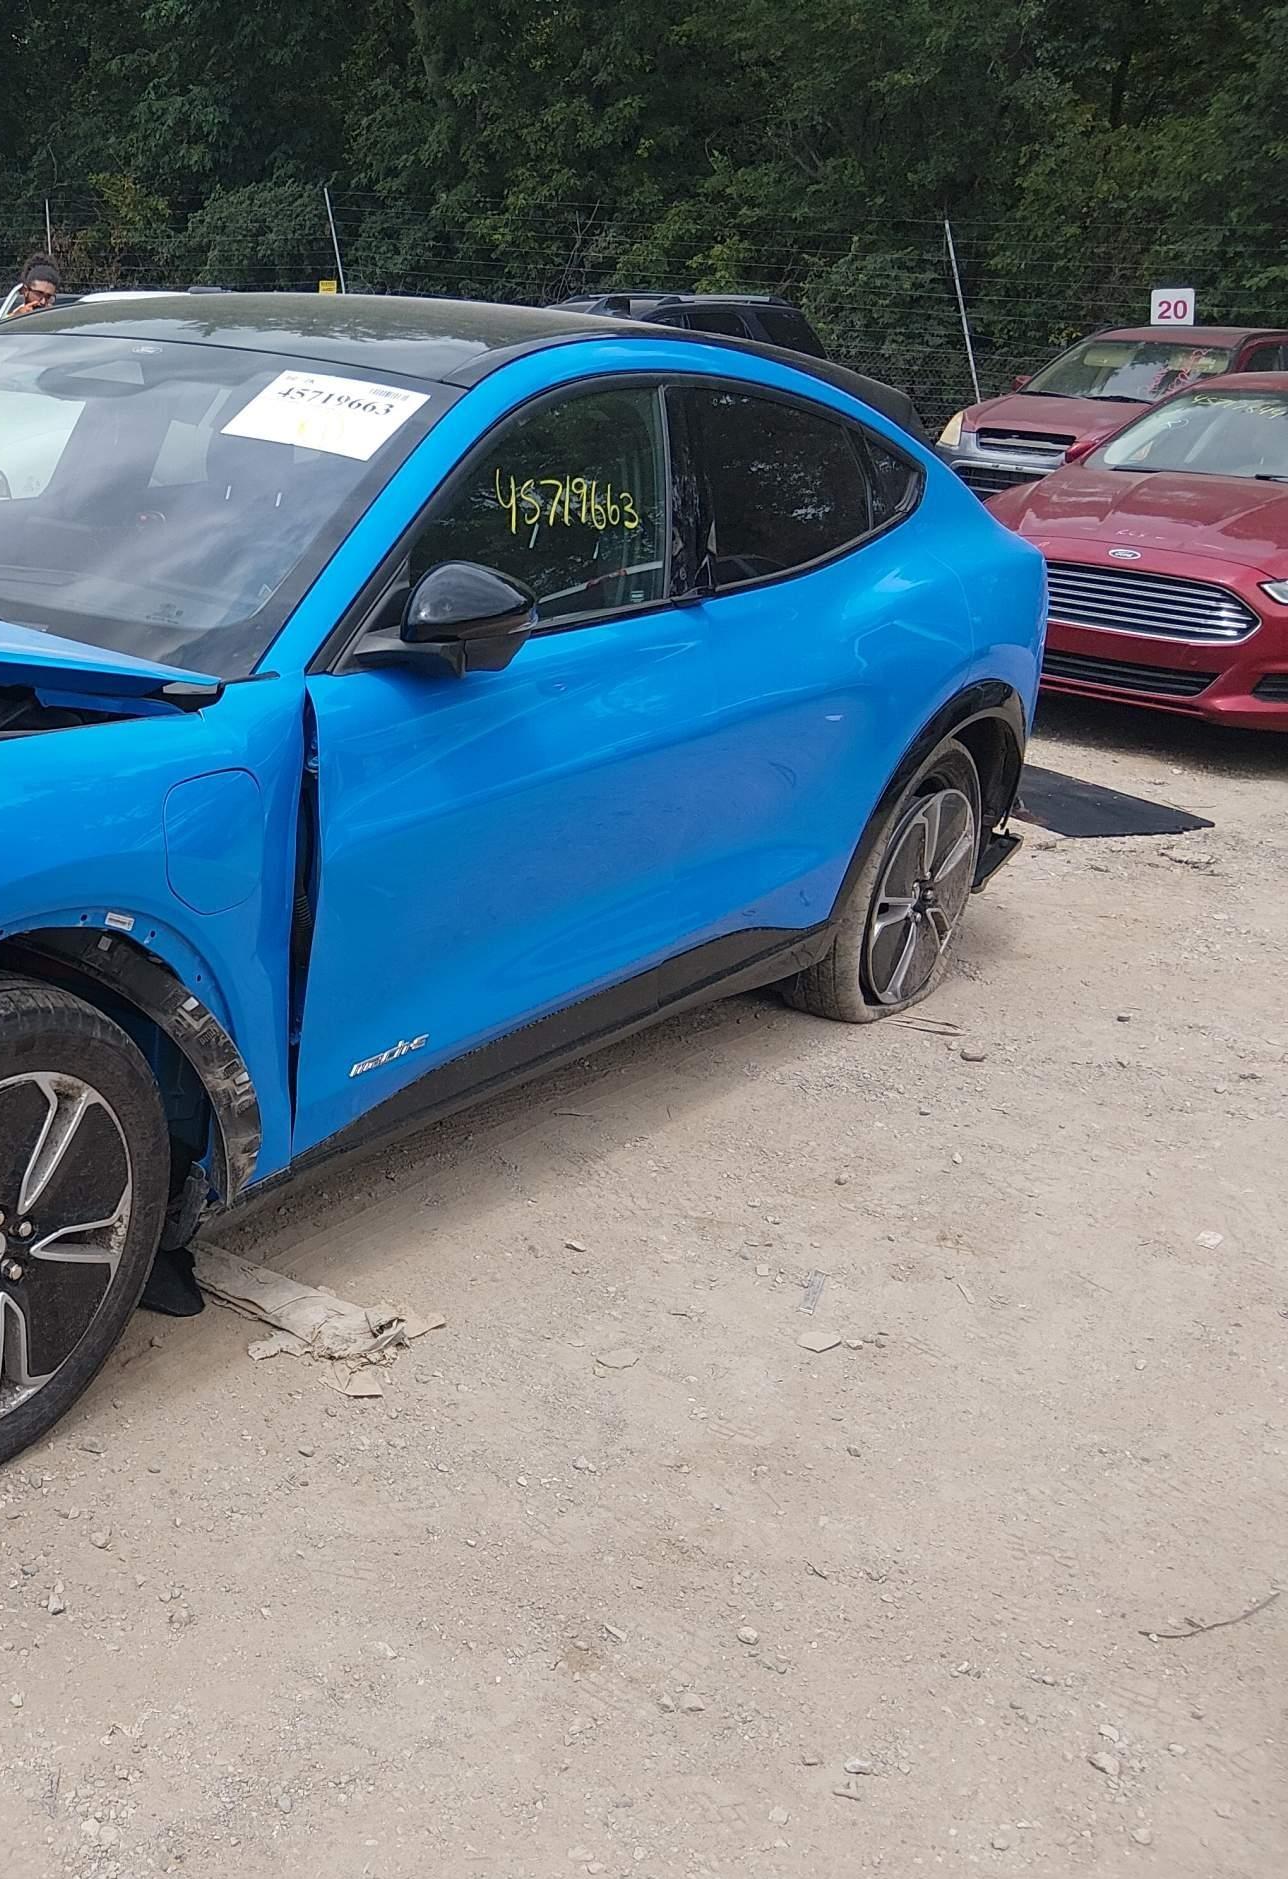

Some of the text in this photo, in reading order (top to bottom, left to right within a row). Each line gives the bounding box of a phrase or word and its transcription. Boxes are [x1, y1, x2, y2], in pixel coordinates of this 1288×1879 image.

[1157, 299, 1188, 320] 20
[277, 385, 396, 416] 45719663
[495, 467, 639, 536] 45719663
